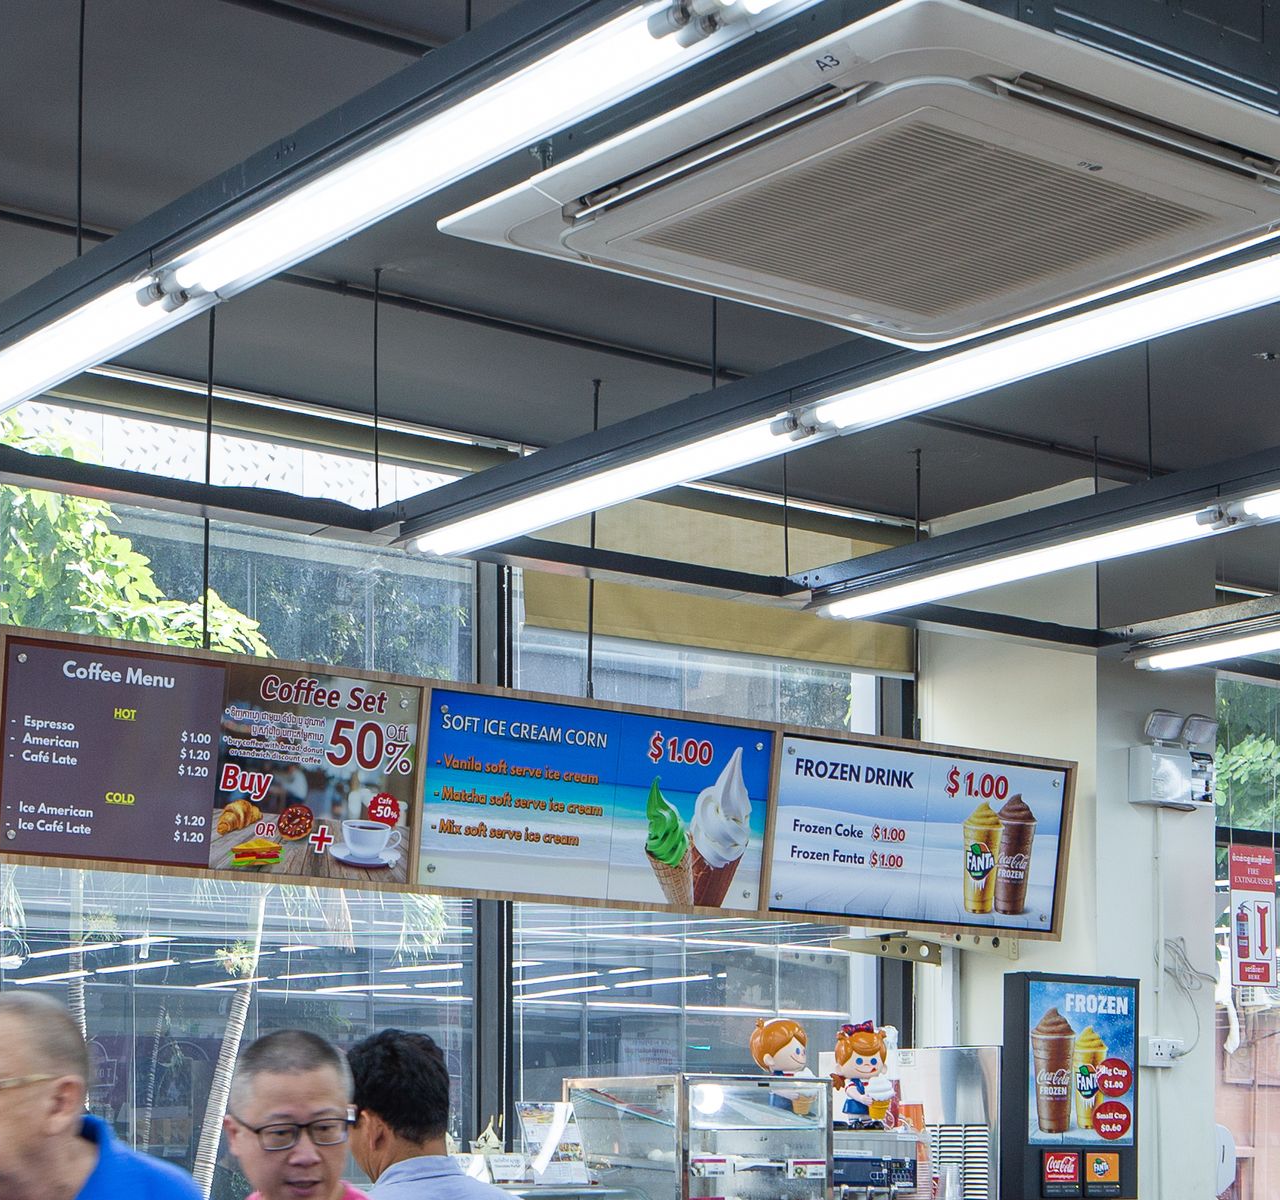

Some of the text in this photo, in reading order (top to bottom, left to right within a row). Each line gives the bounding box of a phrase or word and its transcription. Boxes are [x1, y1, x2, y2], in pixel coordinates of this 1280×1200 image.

[62, 659, 175, 690] Coffee Menu
[260, 674, 388, 714] Coffee Set
[114, 706, 136, 721] HOT
[23, 715, 75, 733] Espresso
[386, 723, 409, 742] Off
[441, 713, 608, 749] SOFT ICE CREAM CORN
[22, 733, 79, 750] American
[228, 737, 242, 748] buy
[243, 738, 263, 749] coffee
[264, 741, 280, 751] with
[21, 749, 50, 765] Café
[53, 752, 78, 767] Late
[239, 749, 270, 761] sandwich
[272, 752, 301, 763] discount
[302, 755, 321, 765] coffee
[444, 753, 599, 785] Vanila soft serve ice cream
[795, 757, 914, 789] FROZEN DRINK
[220, 763, 273, 801] Buy
[105, 790, 136, 806] COLD
[441, 786, 604, 817] Matcha soft serve ice cream
[19, 801, 36, 814] Ice
[38, 803, 94, 818] American
[17, 818, 34, 832] Ice
[36, 819, 64, 835] Café
[67, 823, 91, 836] Late
[255, 820, 276, 839] OR
[438, 819, 579, 846] Mix soft serve ice cream
[793, 819, 832, 836] Frozen
[835, 823, 864, 839] Coke
[790, 845, 830, 862] Frozen
[832, 848, 865, 865] Fanta
[966, 851, 995, 872] FANTA
[997, 868, 1025, 880] FROZEN
[1247, 867, 1260, 876] FIRE
[1065, 993, 1129, 1016] FROZEN
[1113, 1067, 1128, 1079] Cup
[1039, 1086, 1068, 1097] FROZEN
[1103, 1080, 1124, 1090] $1.00
[1096, 1111, 1127, 1122] Small Cup
